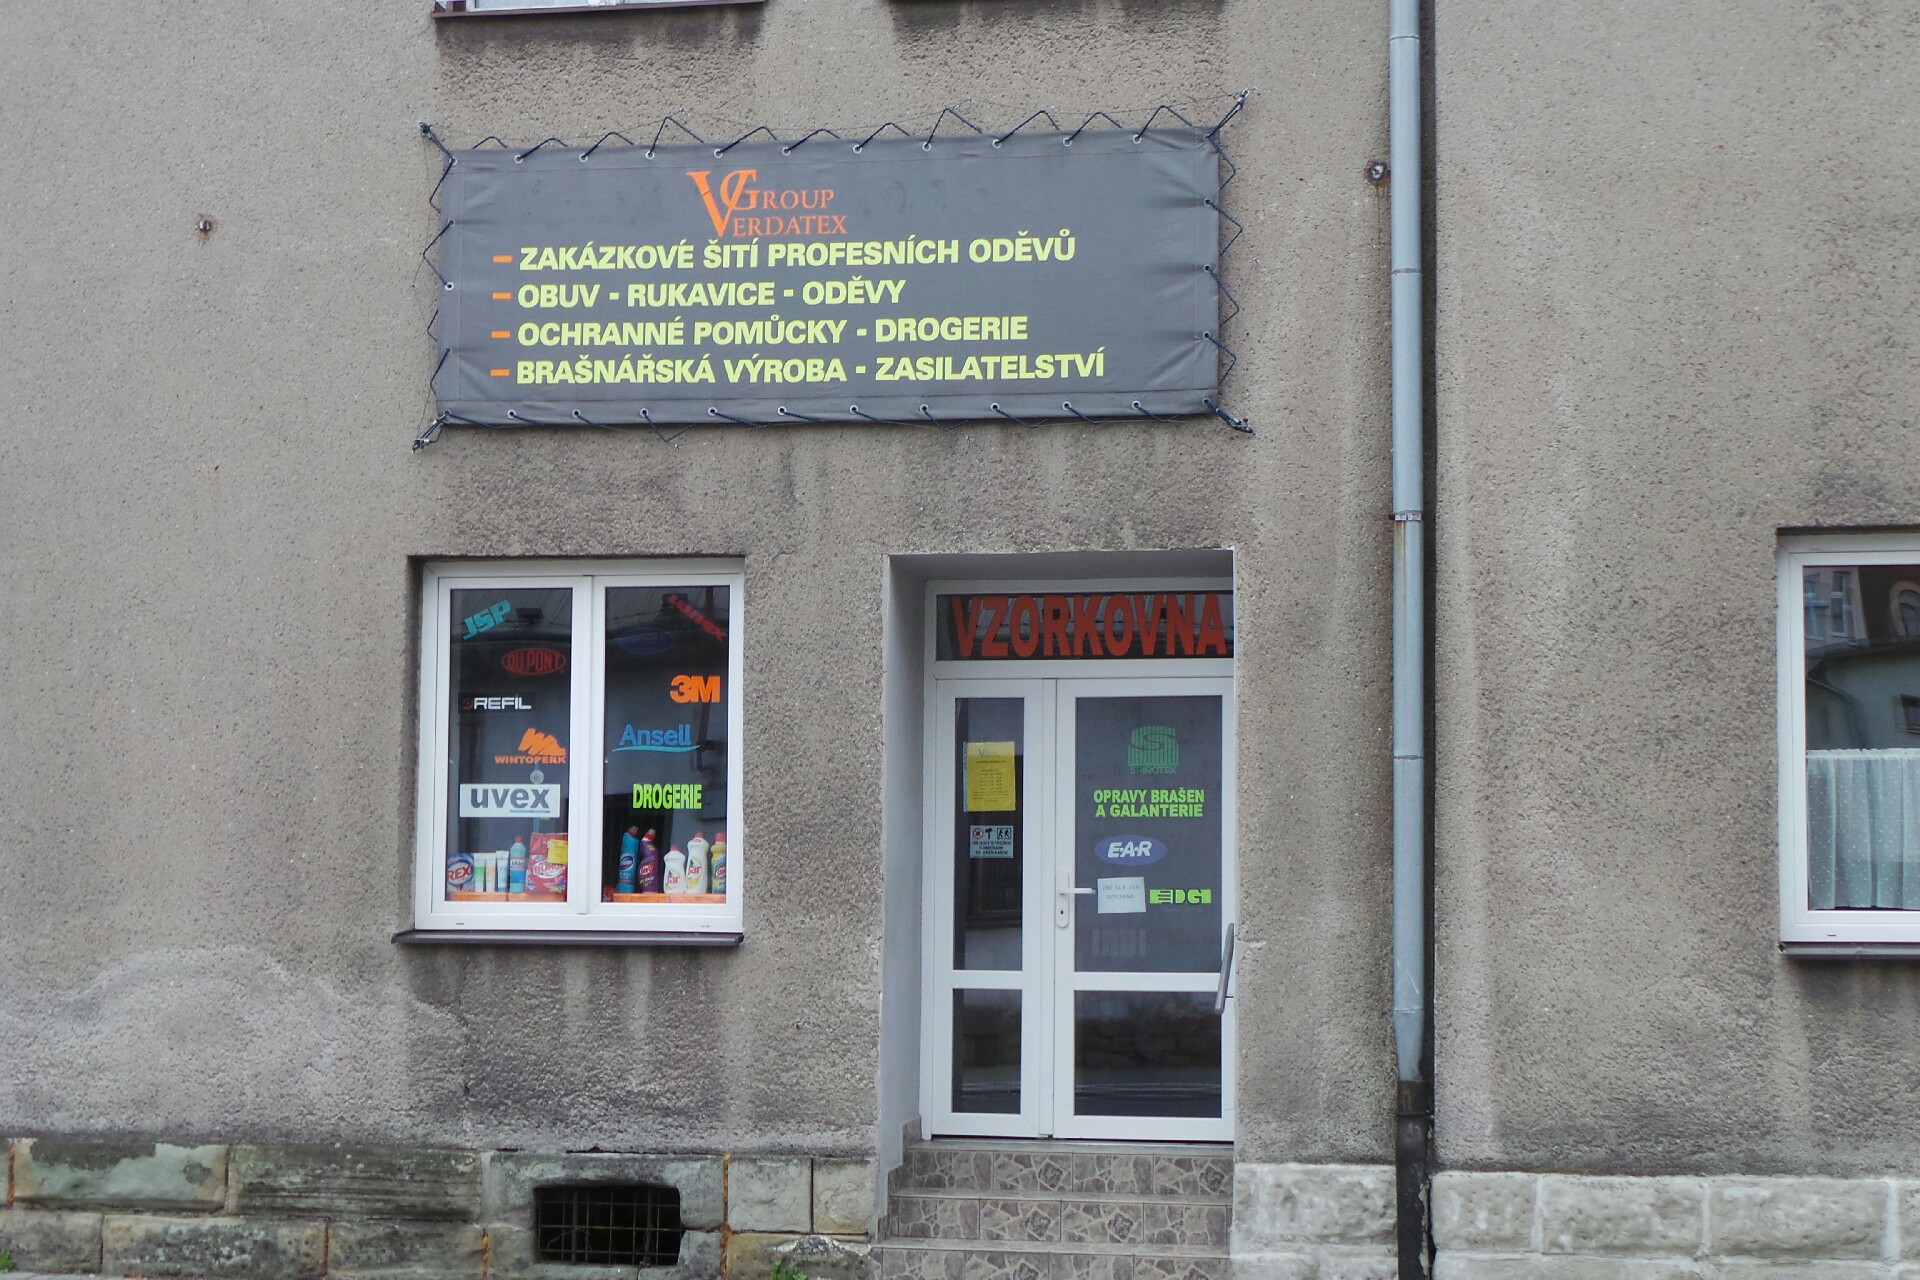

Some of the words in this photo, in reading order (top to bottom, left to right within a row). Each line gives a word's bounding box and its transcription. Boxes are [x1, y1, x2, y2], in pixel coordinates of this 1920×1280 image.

[519, 239, 694, 271] ZAKÁZKOVÉ
[703, 238, 759, 269] ŠITÍ
[768, 234, 959, 267] PROFESNÍCH
[968, 228, 1076, 263] ODĚVŮ
[517, 284, 600, 308] OBUV
[627, 282, 775, 307] RUKAVICE
[802, 275, 906, 305] ODĚVY
[517, 316, 684, 346] OCHRANNÉ
[693, 314, 848, 345] POMŮCKY
[875, 316, 1028, 342] DROGERIE
[516, 353, 716, 384] BRAŠNÁŘSKÁ
[723, 353, 848, 383] VÝROBA
[875, 346, 1105, 381] ZASILATELSTVÍ
[462, 600, 511, 640] JSP
[951, 592, 1228, 658] VZORKOVNA
[669, 675, 721, 703] 3M
[620, 724, 691, 746] Ansell
[471, 788, 550, 809] uvex
[632, 783, 703, 810] DROGERIE
[1093, 789, 1147, 804] OPRAVY
[1151, 787, 1205, 803] BRAŠEN
[1095, 804, 1106, 817] A
[1110, 804, 1203, 817] GALANTERIE
